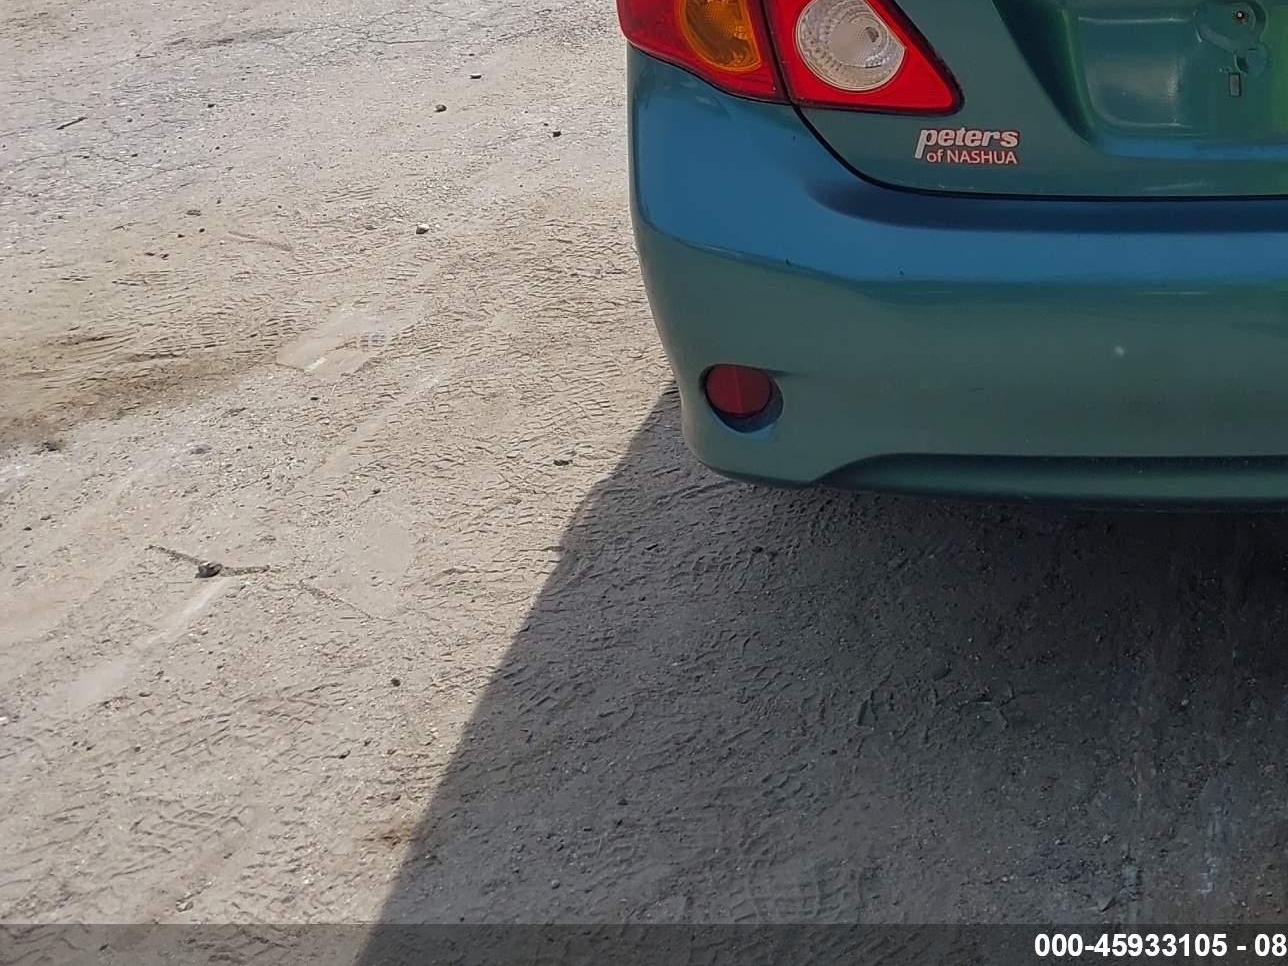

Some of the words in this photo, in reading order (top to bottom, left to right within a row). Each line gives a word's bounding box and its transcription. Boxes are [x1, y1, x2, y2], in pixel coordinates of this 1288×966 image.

[914, 127, 1019, 159] peters
[926, 149, 944, 163] of
[947, 150, 1018, 164] NASHUA
